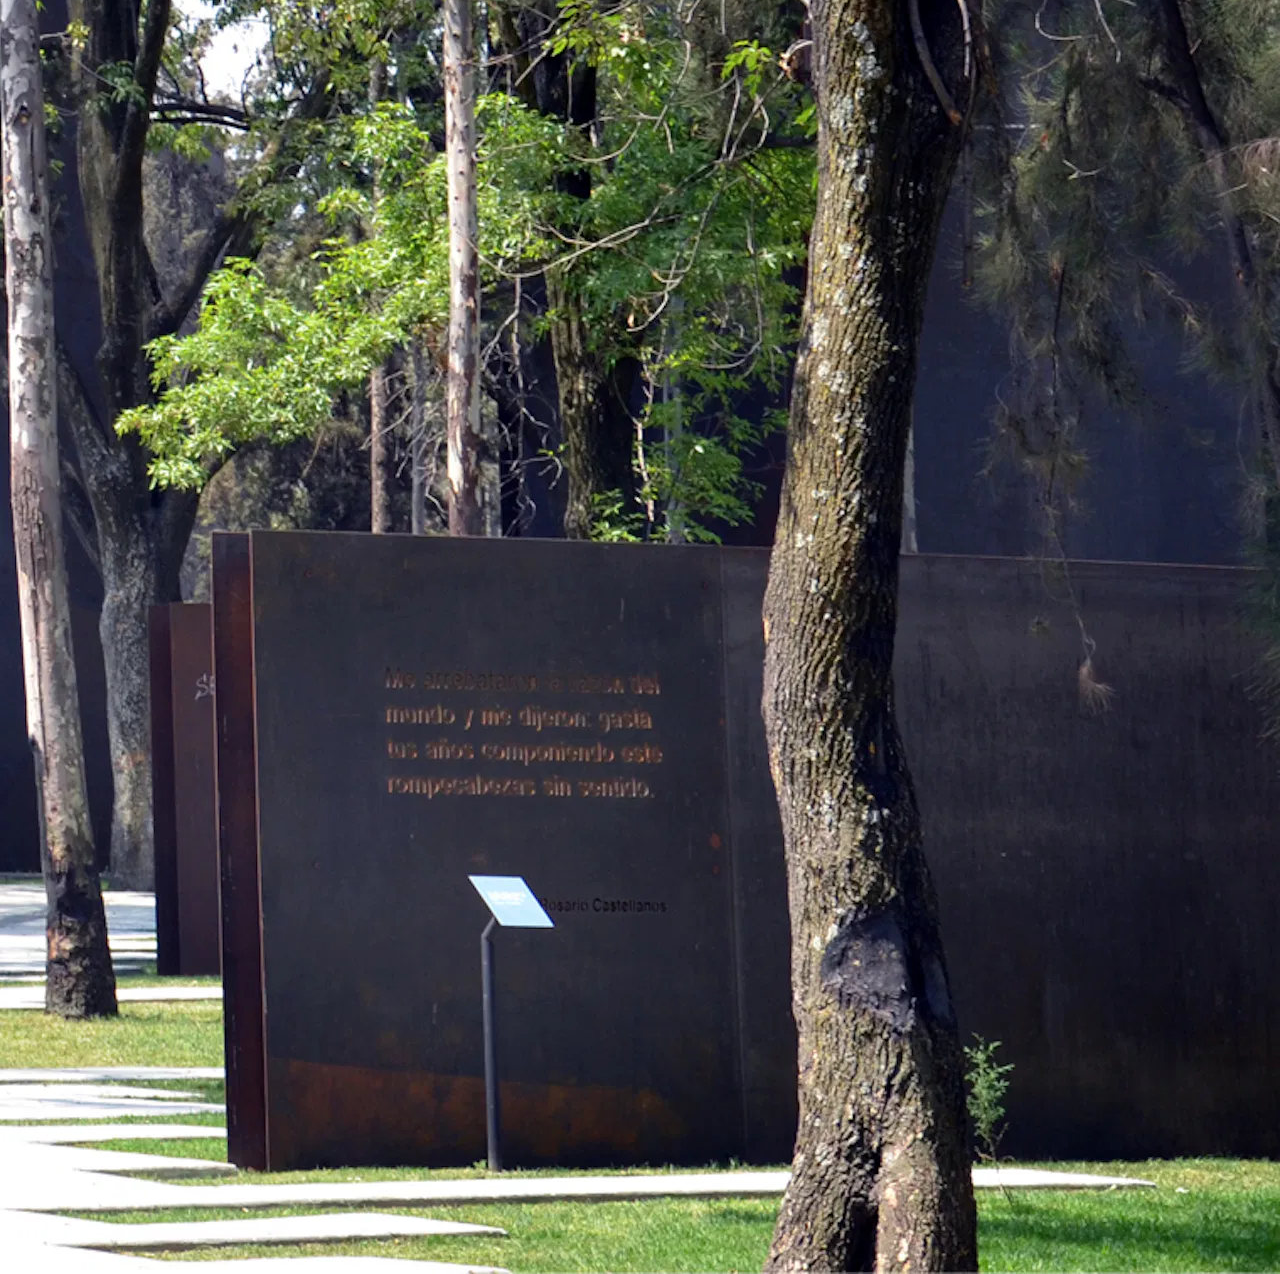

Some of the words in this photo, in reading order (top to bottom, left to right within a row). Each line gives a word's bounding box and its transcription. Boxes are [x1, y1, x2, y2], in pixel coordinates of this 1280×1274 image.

[385, 703, 455, 725] mundo
[464, 709, 474, 730] y
[480, 707, 512, 727] me
[387, 739, 418, 760] tus
[425, 738, 475, 761] años
[481, 741, 615, 767] componiendo
[620, 743, 664, 765] este
[386, 774, 536, 800] rompecabezas
[543, 774, 572, 797] sin
[592, 897, 668, 914] Castellanos
